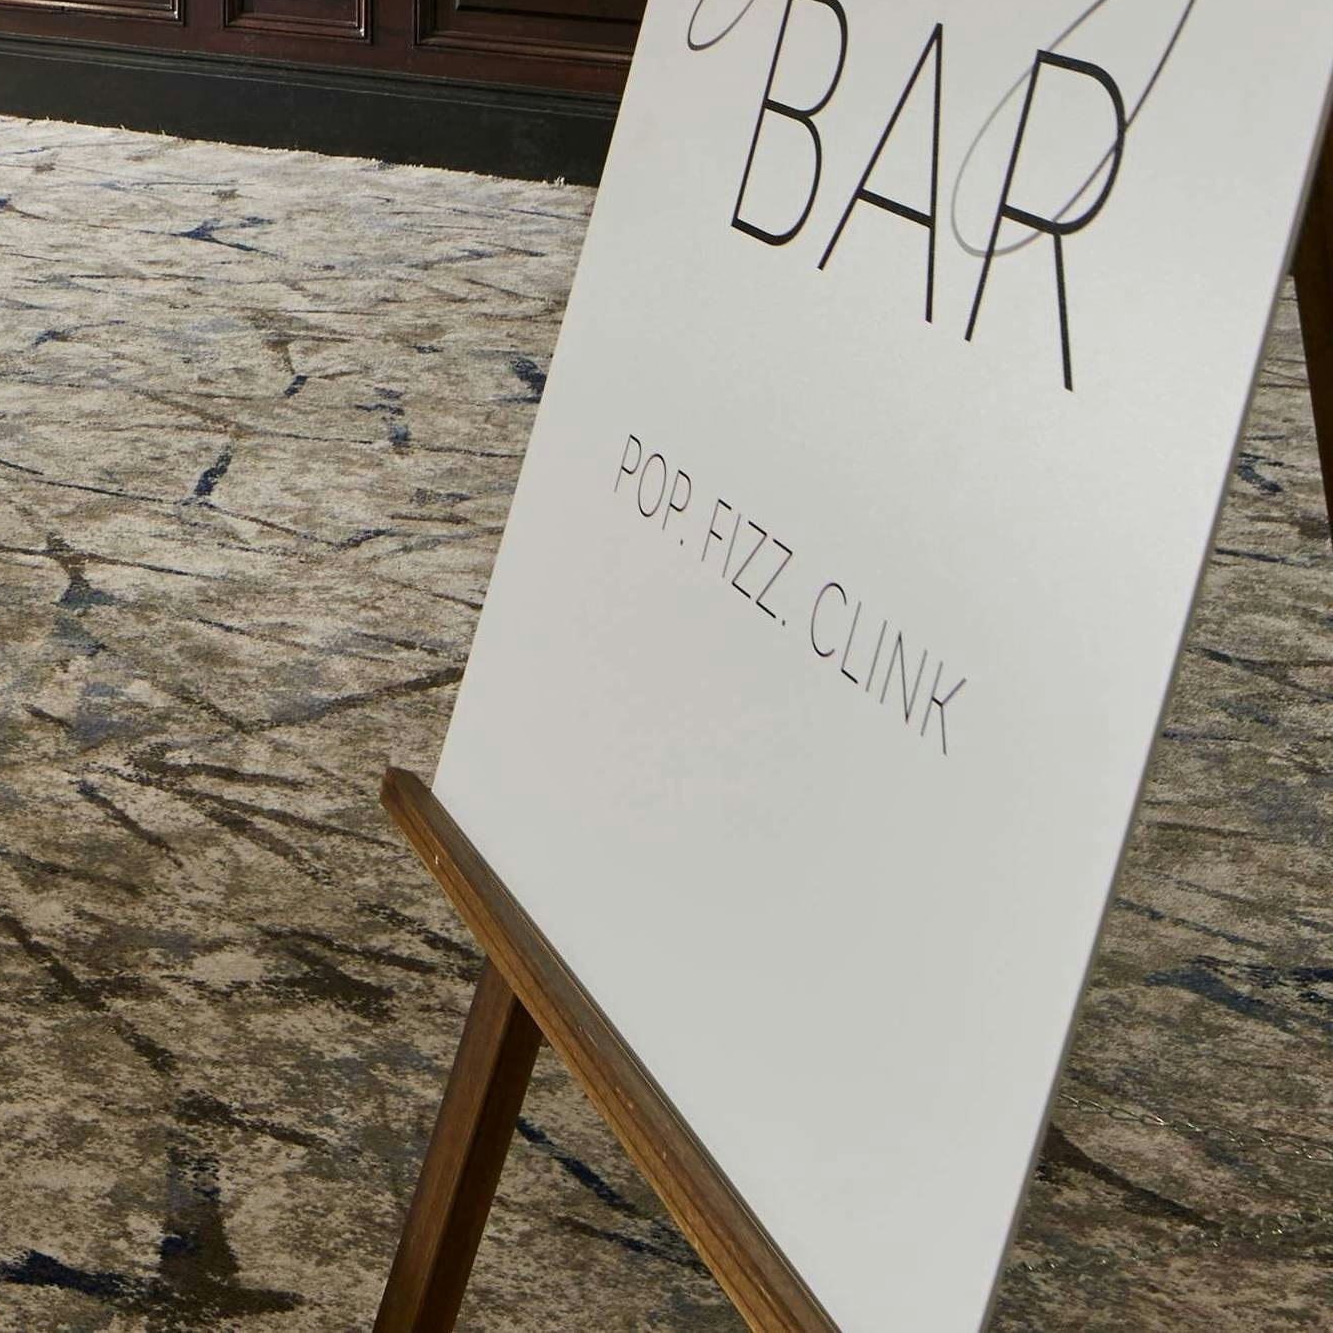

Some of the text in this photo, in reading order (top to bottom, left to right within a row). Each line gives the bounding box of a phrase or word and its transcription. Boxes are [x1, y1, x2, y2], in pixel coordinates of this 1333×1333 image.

[614, 434, 968, 756] POP. FIZZ. CLINK
